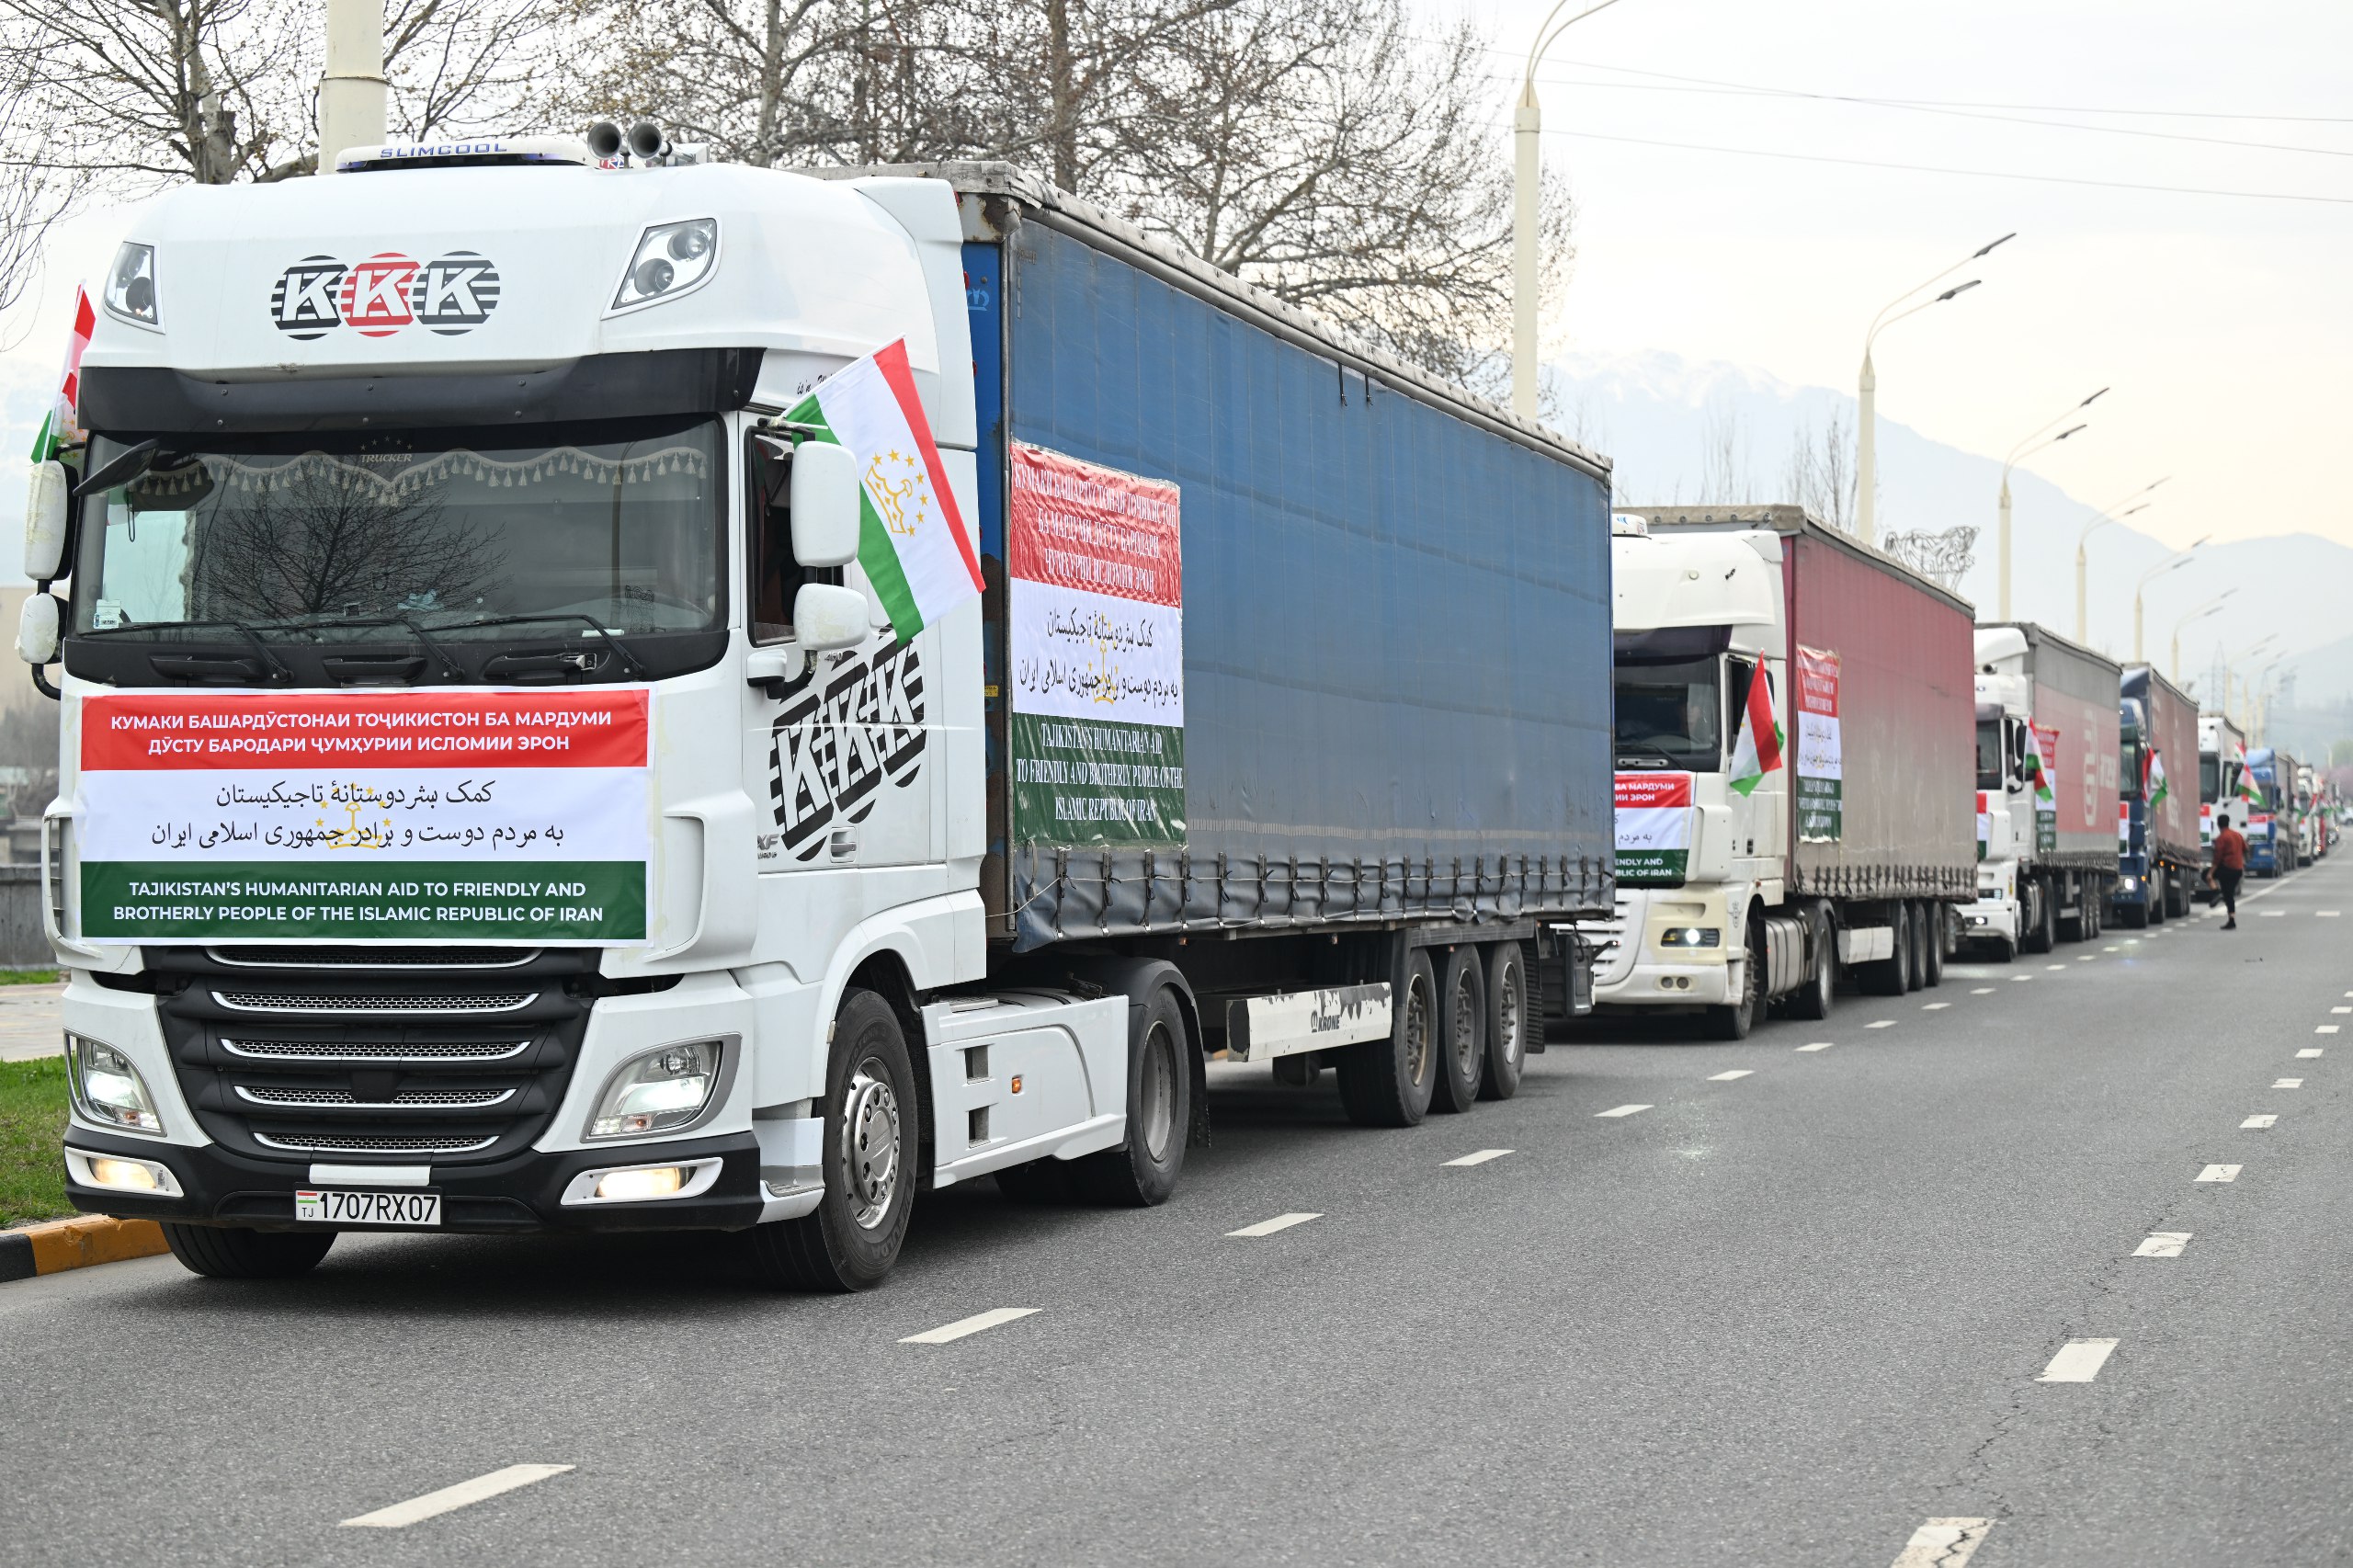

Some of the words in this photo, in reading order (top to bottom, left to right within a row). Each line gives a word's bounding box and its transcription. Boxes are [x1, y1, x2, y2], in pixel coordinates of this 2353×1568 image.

[380, 143, 507, 158] SLIMCOOL
[360, 454, 412, 463] TRUCKER
[1136, 618, 1154, 648] کمک
[111, 715, 184, 730] КУМАКИ
[188, 711, 350, 730] БАШАРДӮСТОНАИ
[355, 713, 479, 729] ТОҶИКИСТОН
[485, 712, 510, 726] БА
[515, 711, 611, 728] МАРДУМИ
[148, 737, 205, 755] ДӮСТУ
[209, 738, 306, 754] БАРОДАРИ
[311, 737, 412, 754] ҶУМҲУРИИ
[417, 736, 512, 751] ИСЛОМИИ
[518, 736, 569, 750] ЭРОН
[1150, 732, 1162, 755] AID
[1016, 758, 1028, 783] TO
[1030, 759, 1069, 784] FRIENDLY
[1070, 761, 1088, 784] AND
[1089, 762, 1131, 786] BROTHERLY
[1132, 765, 1159, 788] PEOPLE
[1170, 767, 1183, 789] THE
[216, 780, 323, 808] تاجیکیستان
[446, 779, 496, 803] کمک
[1629, 782, 1675, 791] МАРДУМИ
[1055, 796, 1087, 821] ISLAMIC
[1089, 797, 1125, 821] REPUBLIC
[1136, 799, 1156, 821] IRAN
[152, 822, 192, 849] ایران
[199, 820, 258, 849] اسلامی
[265, 825, 344, 849] جمهوری
[351, 821, 394, 848] برادر
[400, 829, 413, 847] و
[418, 825, 484, 847] دوست
[492, 827, 537, 851] مردم
[545, 825, 564, 847] به
[757, 834, 780, 850] XF
[129, 882, 241, 896] TAJIKISTAN’S
[245, 882, 382, 896] HUMANITARIAN
[387, 882, 419, 896] AID
[424, 882, 449, 896] TO
[453, 882, 541, 896] FRIENDLY
[545, 882, 586, 897] AND
[113, 906, 214, 920] BROTHERLY
[219, 906, 287, 920] PEOPLE
[291, 907, 316, 920] OF
[320, 907, 355, 920] THE
[359, 907, 431, 921] ISLAMIC
[436, 907, 525, 921] REPUBLIC
[530, 907, 555, 921] OF
[560, 908, 603, 921] IRAN
[1318, 1014, 1340, 1032] KRONE
[301, 1207, 314, 1218] TJ
[319, 1192, 437, 1222] 1707RX07
